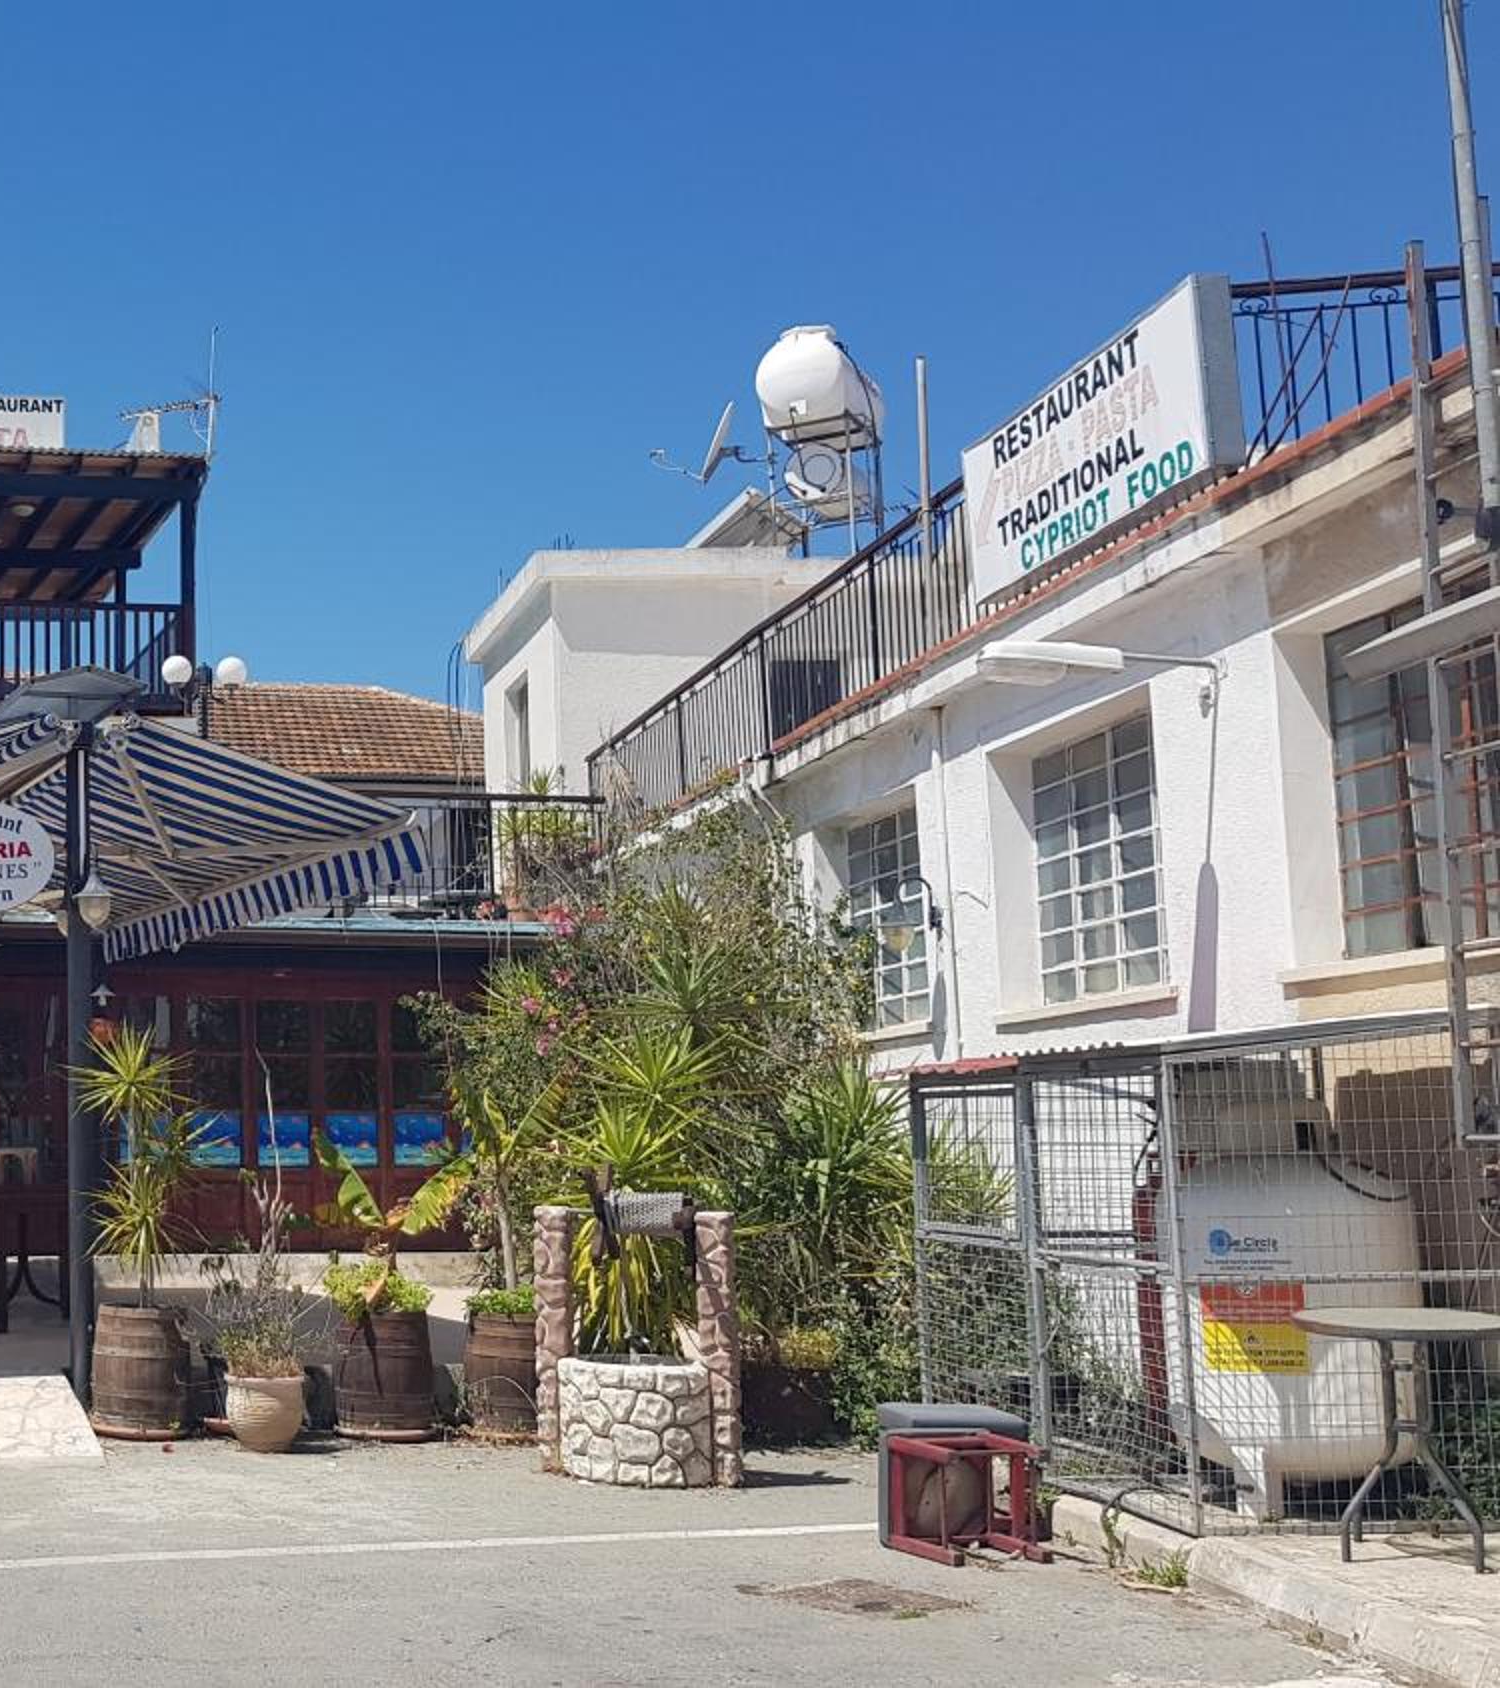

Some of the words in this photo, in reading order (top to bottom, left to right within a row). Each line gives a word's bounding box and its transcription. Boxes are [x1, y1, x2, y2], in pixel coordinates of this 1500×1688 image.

[993, 329, 1139, 469] RESTAURANT
[995, 431, 1064, 507] PIZZA
[1080, 364, 1160, 458] PASTA
[998, 429, 1145, 547] TRADITIONAL
[1020, 487, 1111, 571] CYPRIOT
[1126, 440, 1194, 509] FOOD
